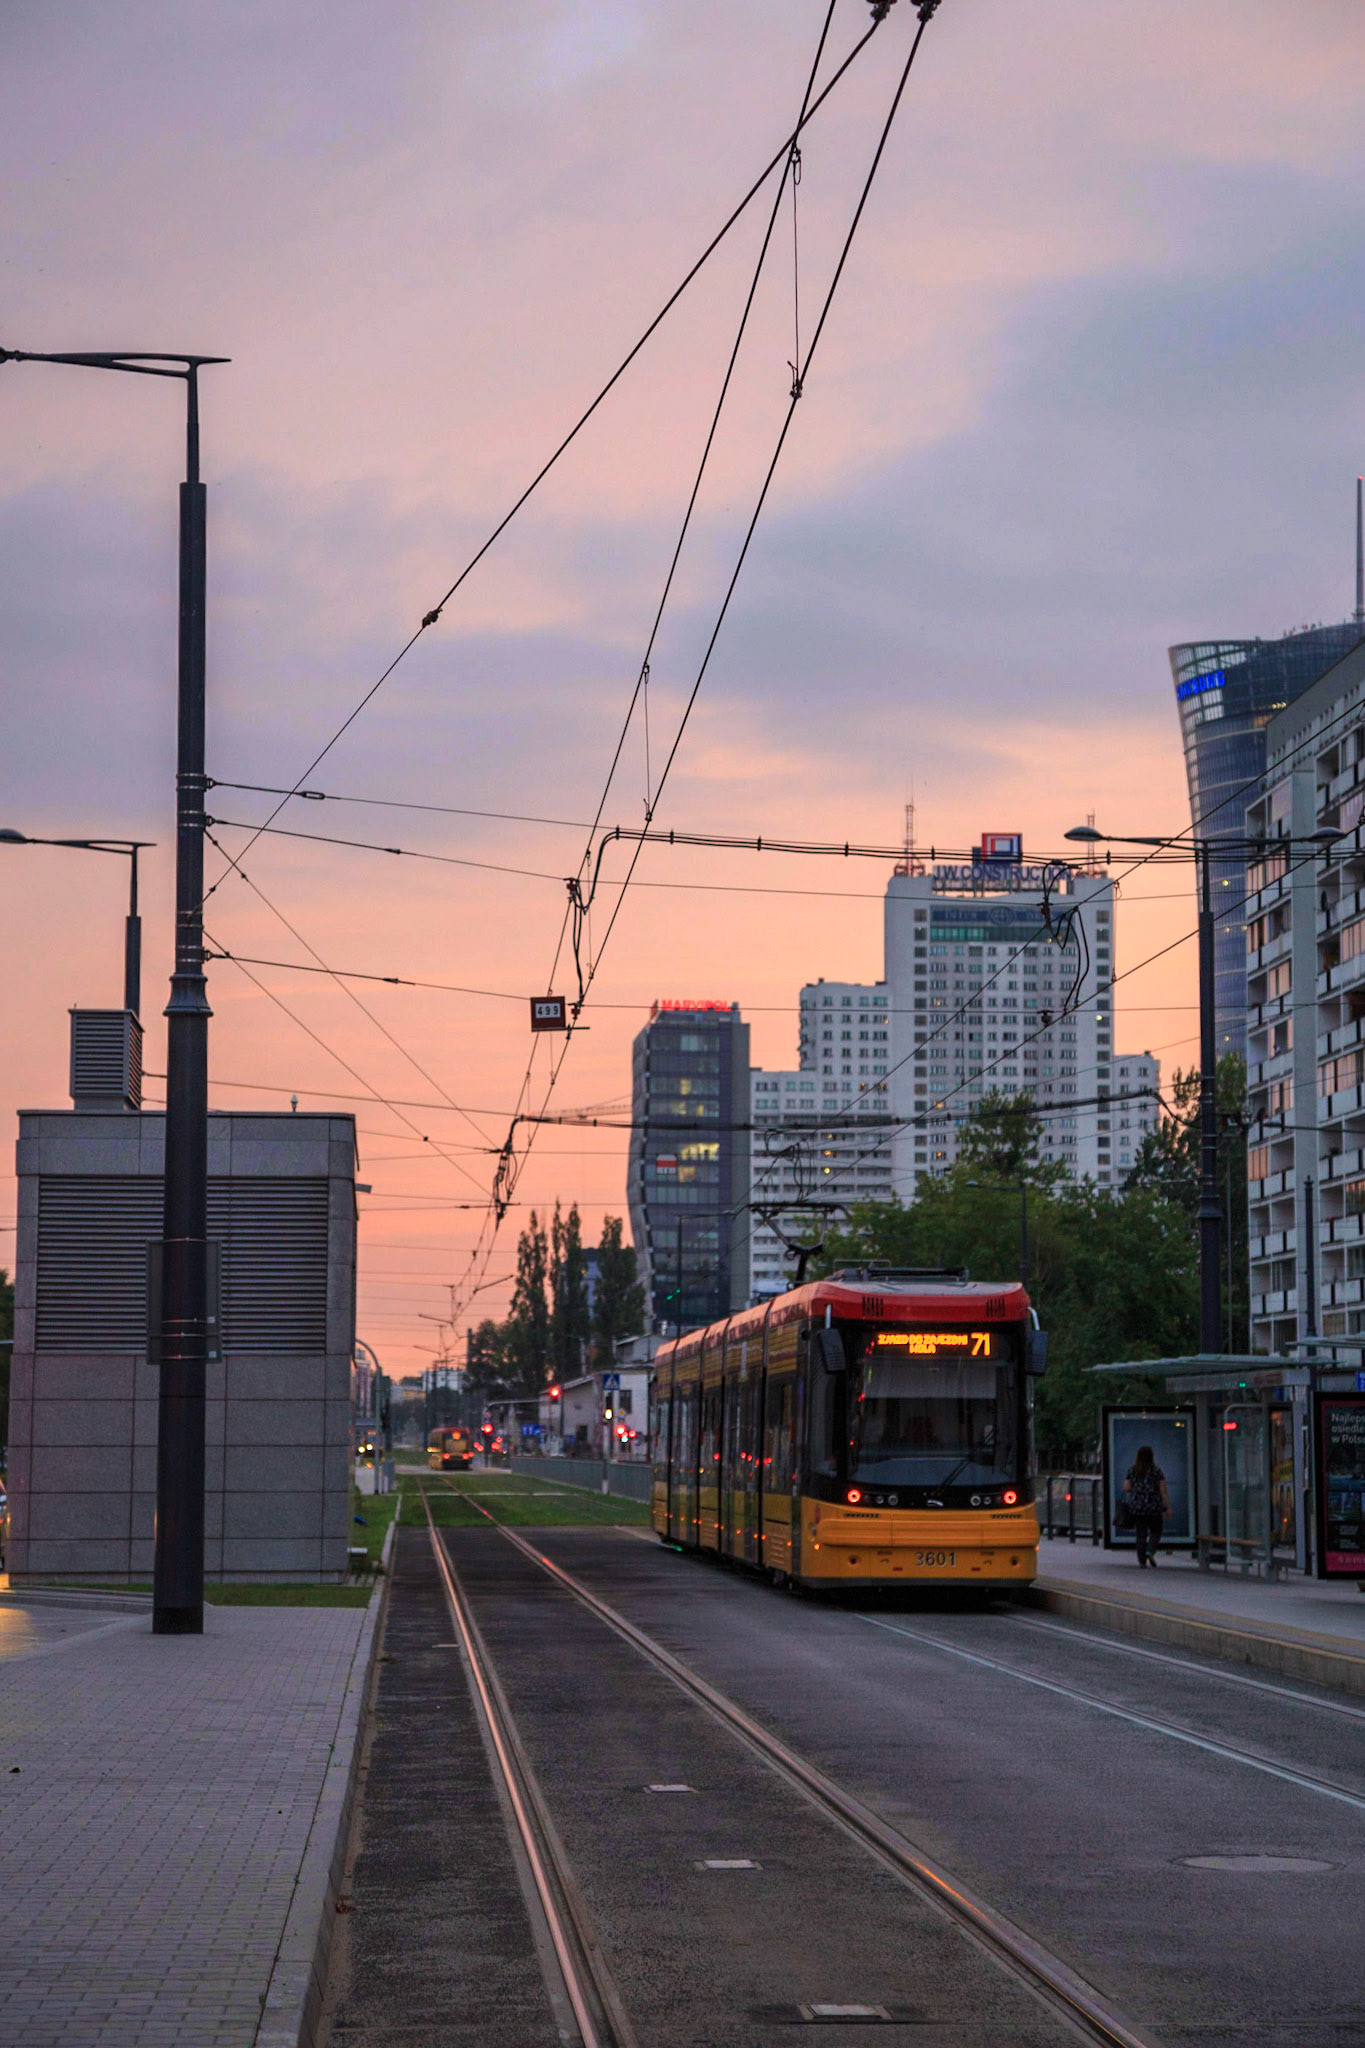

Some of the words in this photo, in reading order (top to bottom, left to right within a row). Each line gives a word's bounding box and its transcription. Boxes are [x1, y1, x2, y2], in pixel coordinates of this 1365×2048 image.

[537, 1005, 559, 1015] 499
[662, 1000, 732, 1012] MARVIPOL
[878, 1334, 908, 1345] ZJAZD
[909, 1334, 923, 1345] DO
[923, 1334, 968, 1345] ZAJEZDNI
[971, 1332, 990, 1356] 71
[909, 1344, 936, 1354] WOLA
[914, 1551, 956, 1568] 3601
